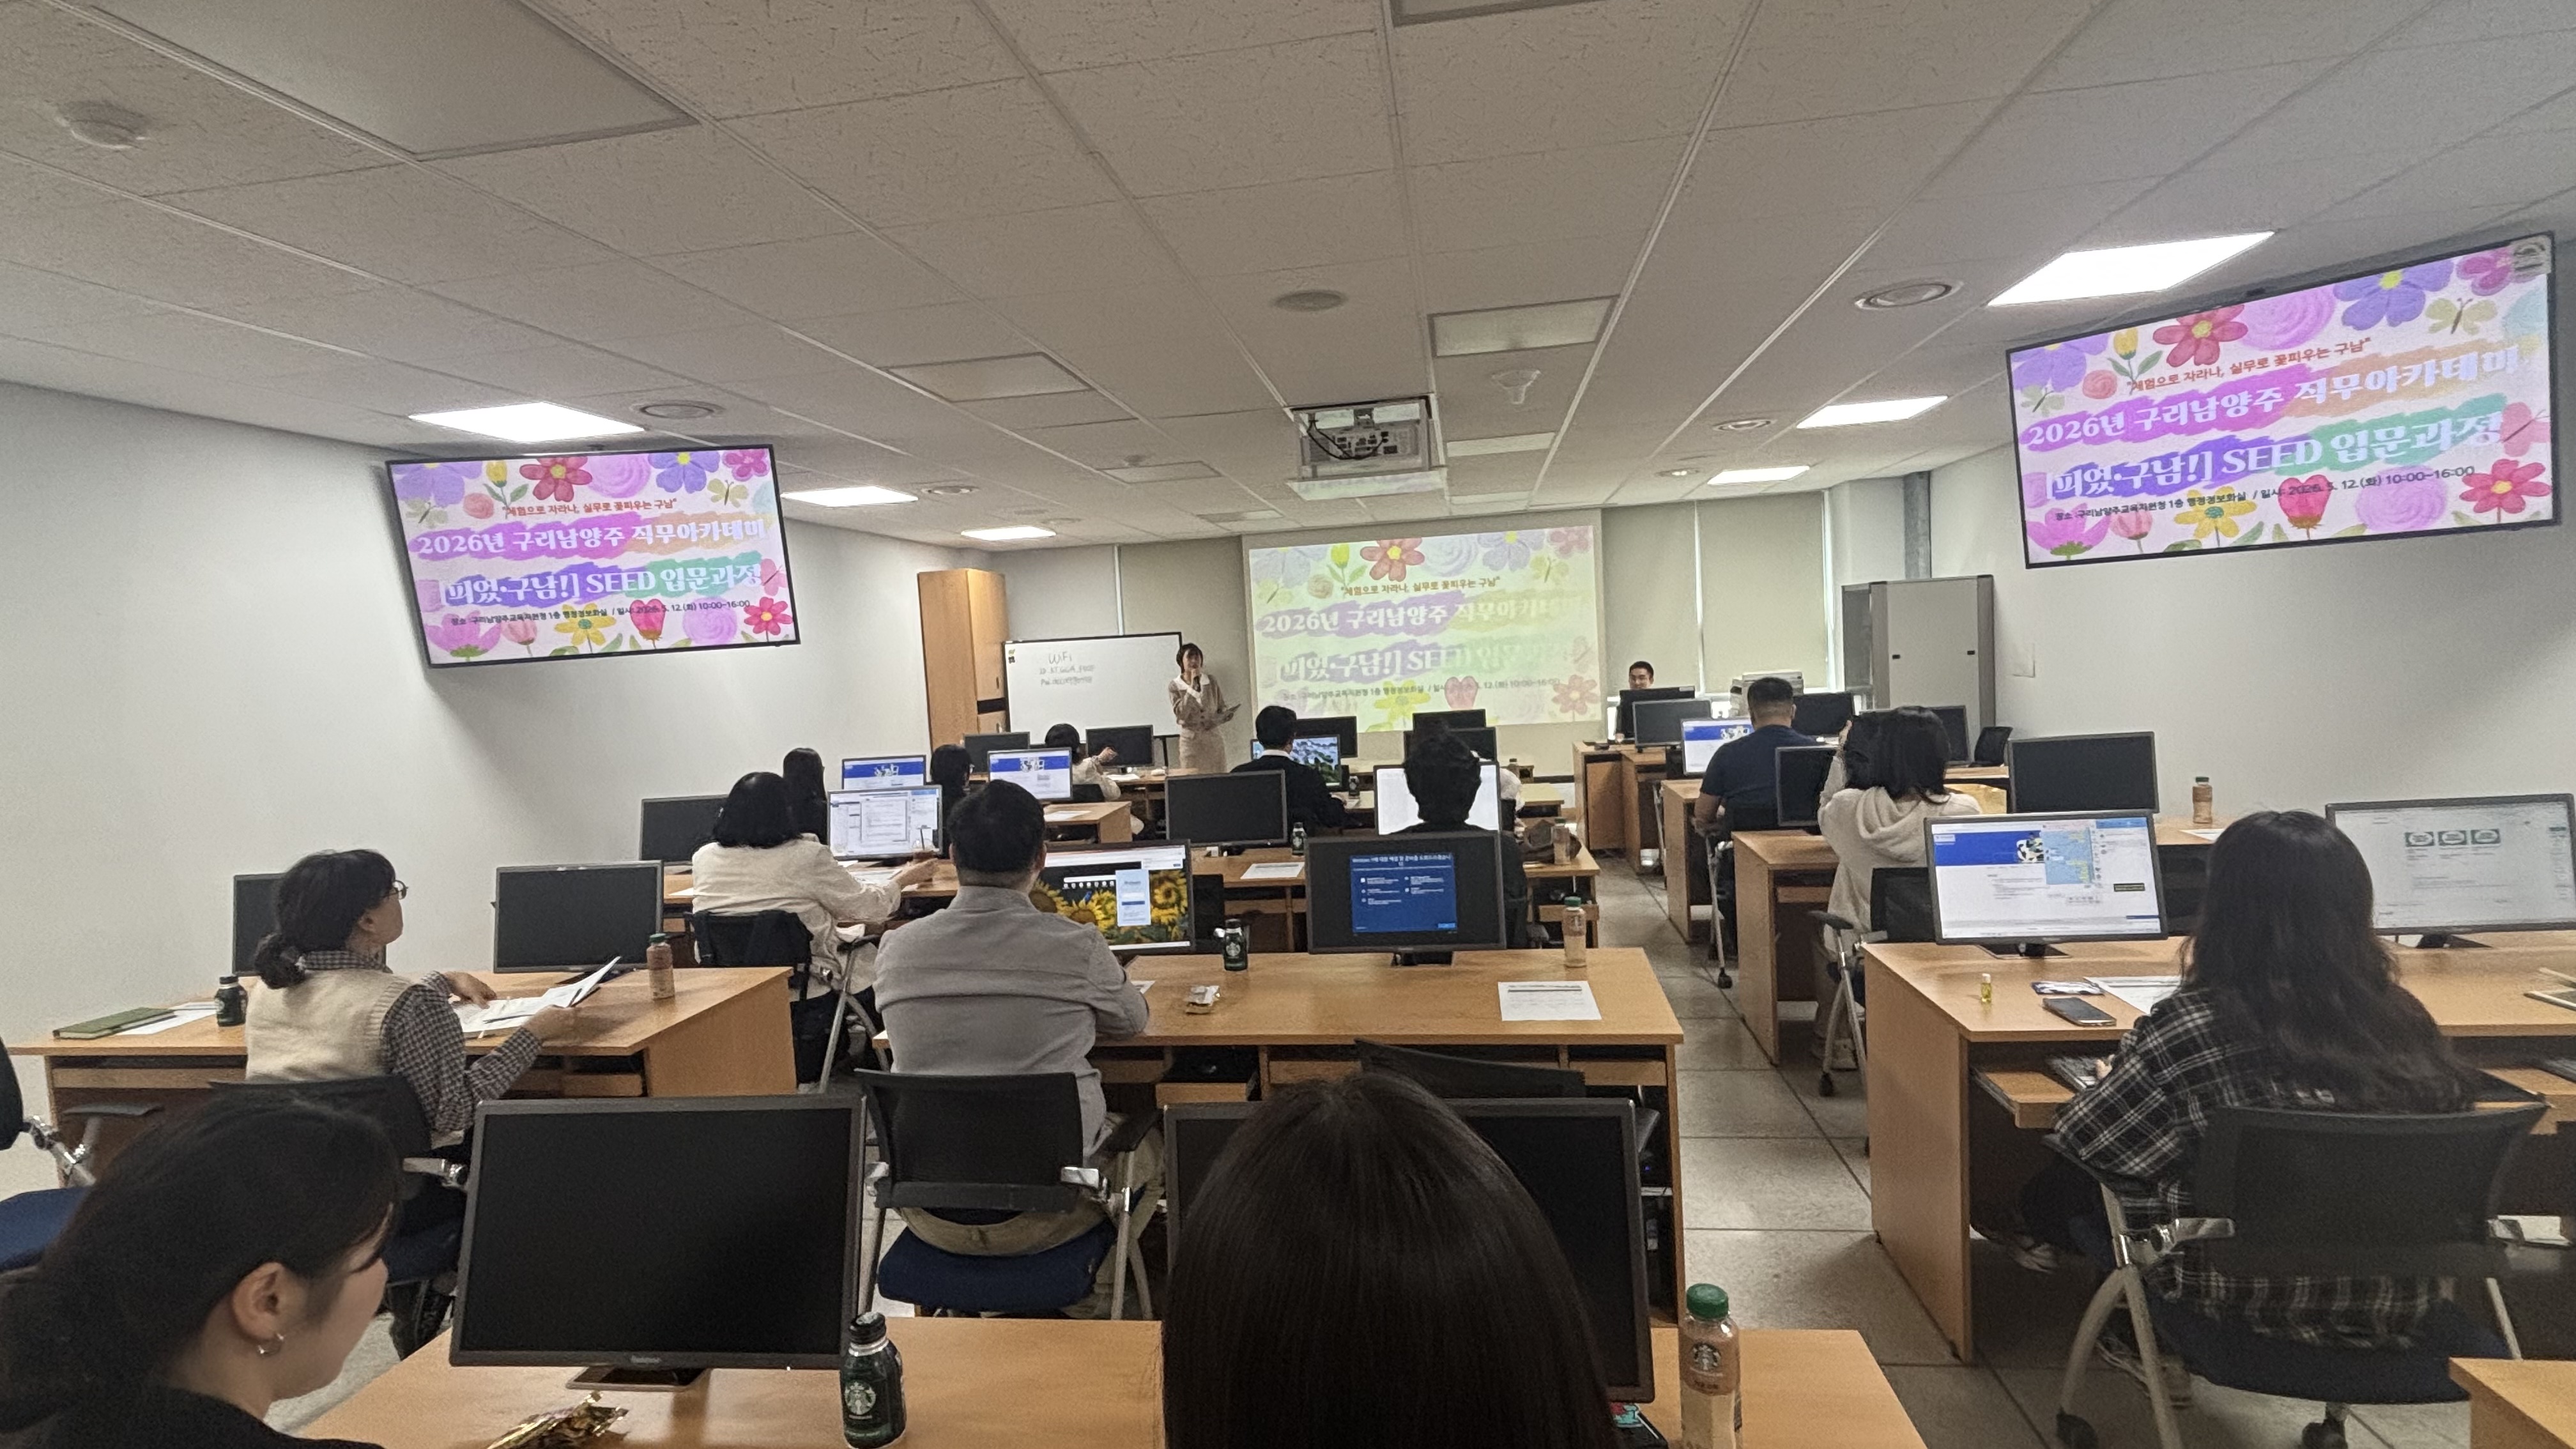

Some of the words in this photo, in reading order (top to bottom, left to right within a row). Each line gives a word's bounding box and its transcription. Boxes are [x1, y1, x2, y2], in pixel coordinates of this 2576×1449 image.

[2184, 366, 2225, 381] 자라나,
[2230, 358, 2270, 374] 실무로
[2274, 348, 2329, 366] 꽃피우는
[2029, 411, 2125, 445] 2026년
[2134, 387, 2284, 431] 구리남양주
[2294, 346, 2518, 404] 직무아카데미
[2221, 439, 2322, 473] SEED
[2331, 411, 2502, 463] 입문과정
[548, 504, 579, 514] 자라나,
[583, 502, 612, 513] 실무로
[614, 500, 652, 511] 꽃피우는
[418, 532, 505, 555] 2026년
[512, 527, 625, 551] 구리남양주
[632, 519, 766, 545] 직무아카데미
[586, 571, 656, 593] SEED
[660, 564, 762, 592] 입문과정
[1263, 611, 1339, 632] 2026년
[1346, 605, 1448, 629] 구리남양주
